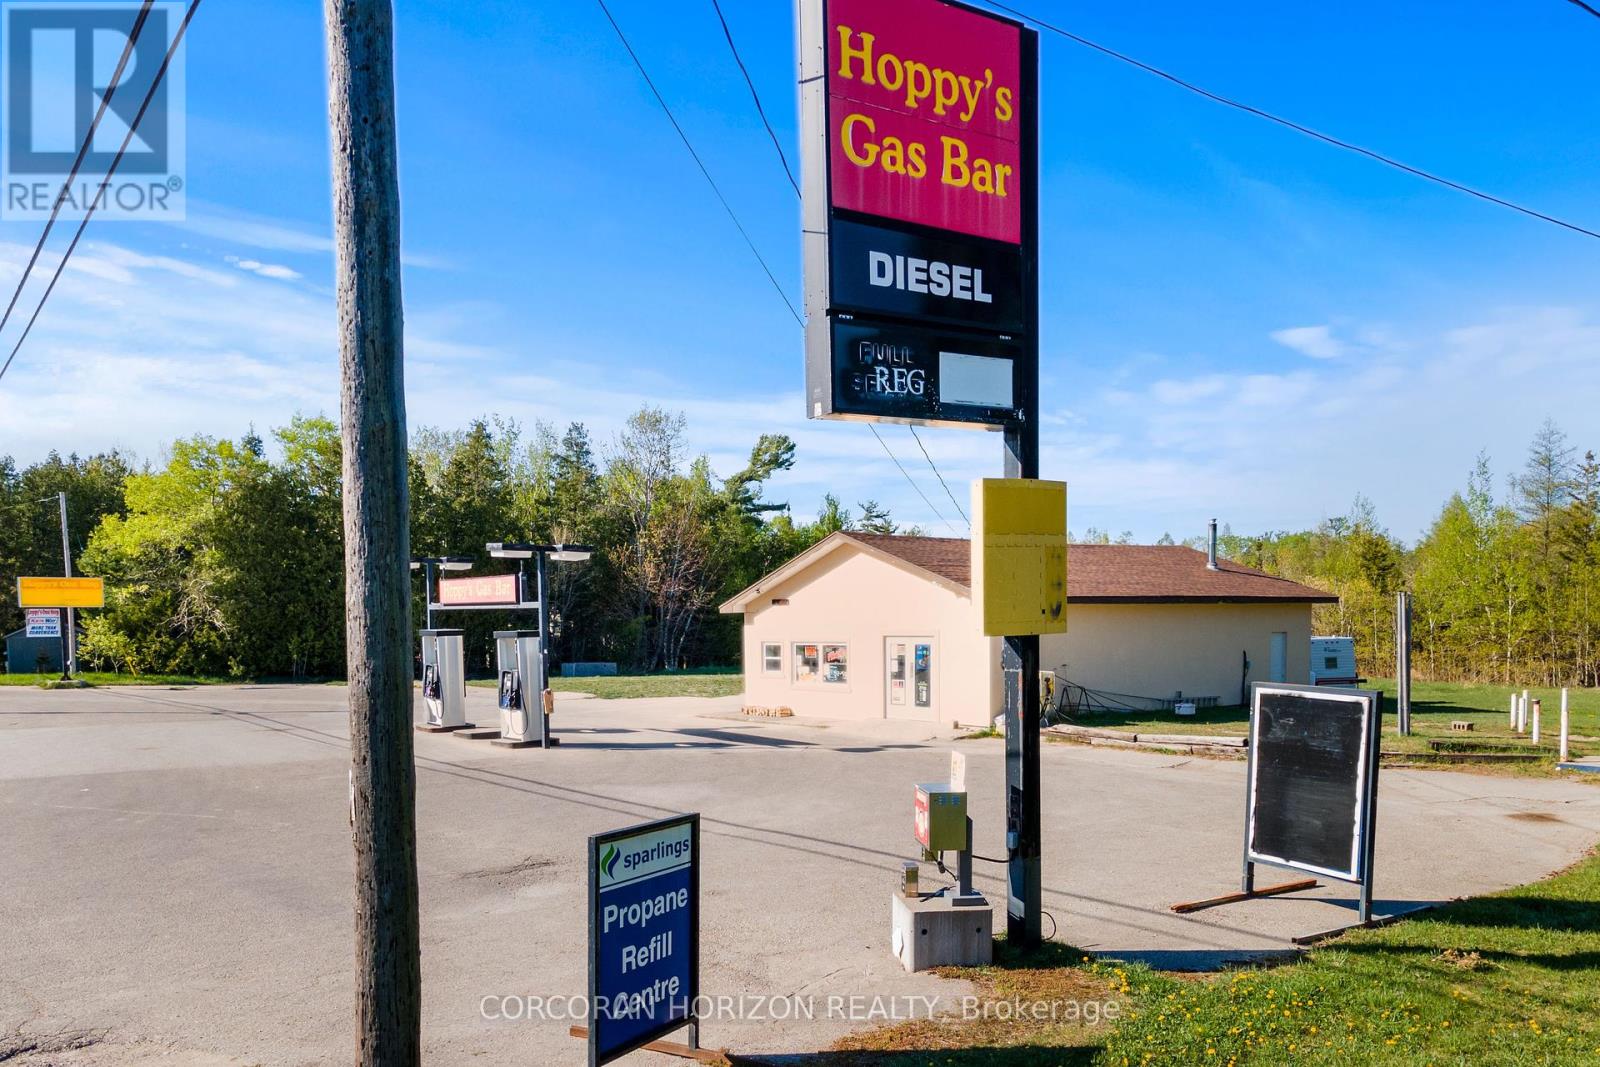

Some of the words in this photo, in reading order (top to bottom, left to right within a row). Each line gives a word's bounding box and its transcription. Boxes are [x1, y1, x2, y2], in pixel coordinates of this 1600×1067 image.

[837, 25, 1012, 122] Hoppy's
[841, 114, 927, 178] Gas
[941, 135, 1012, 197] Bar
[869, 250, 992, 303] DIESEL
[874, 366, 925, 395] REG
[475, 580, 491, 596] Gas
[495, 580, 512, 596] Bar
[624, 838, 690, 870] sparlings
[603, 887, 688, 933] Propane
[622, 931, 672, 974] Refill
[613, 975, 680, 1019] Centre
